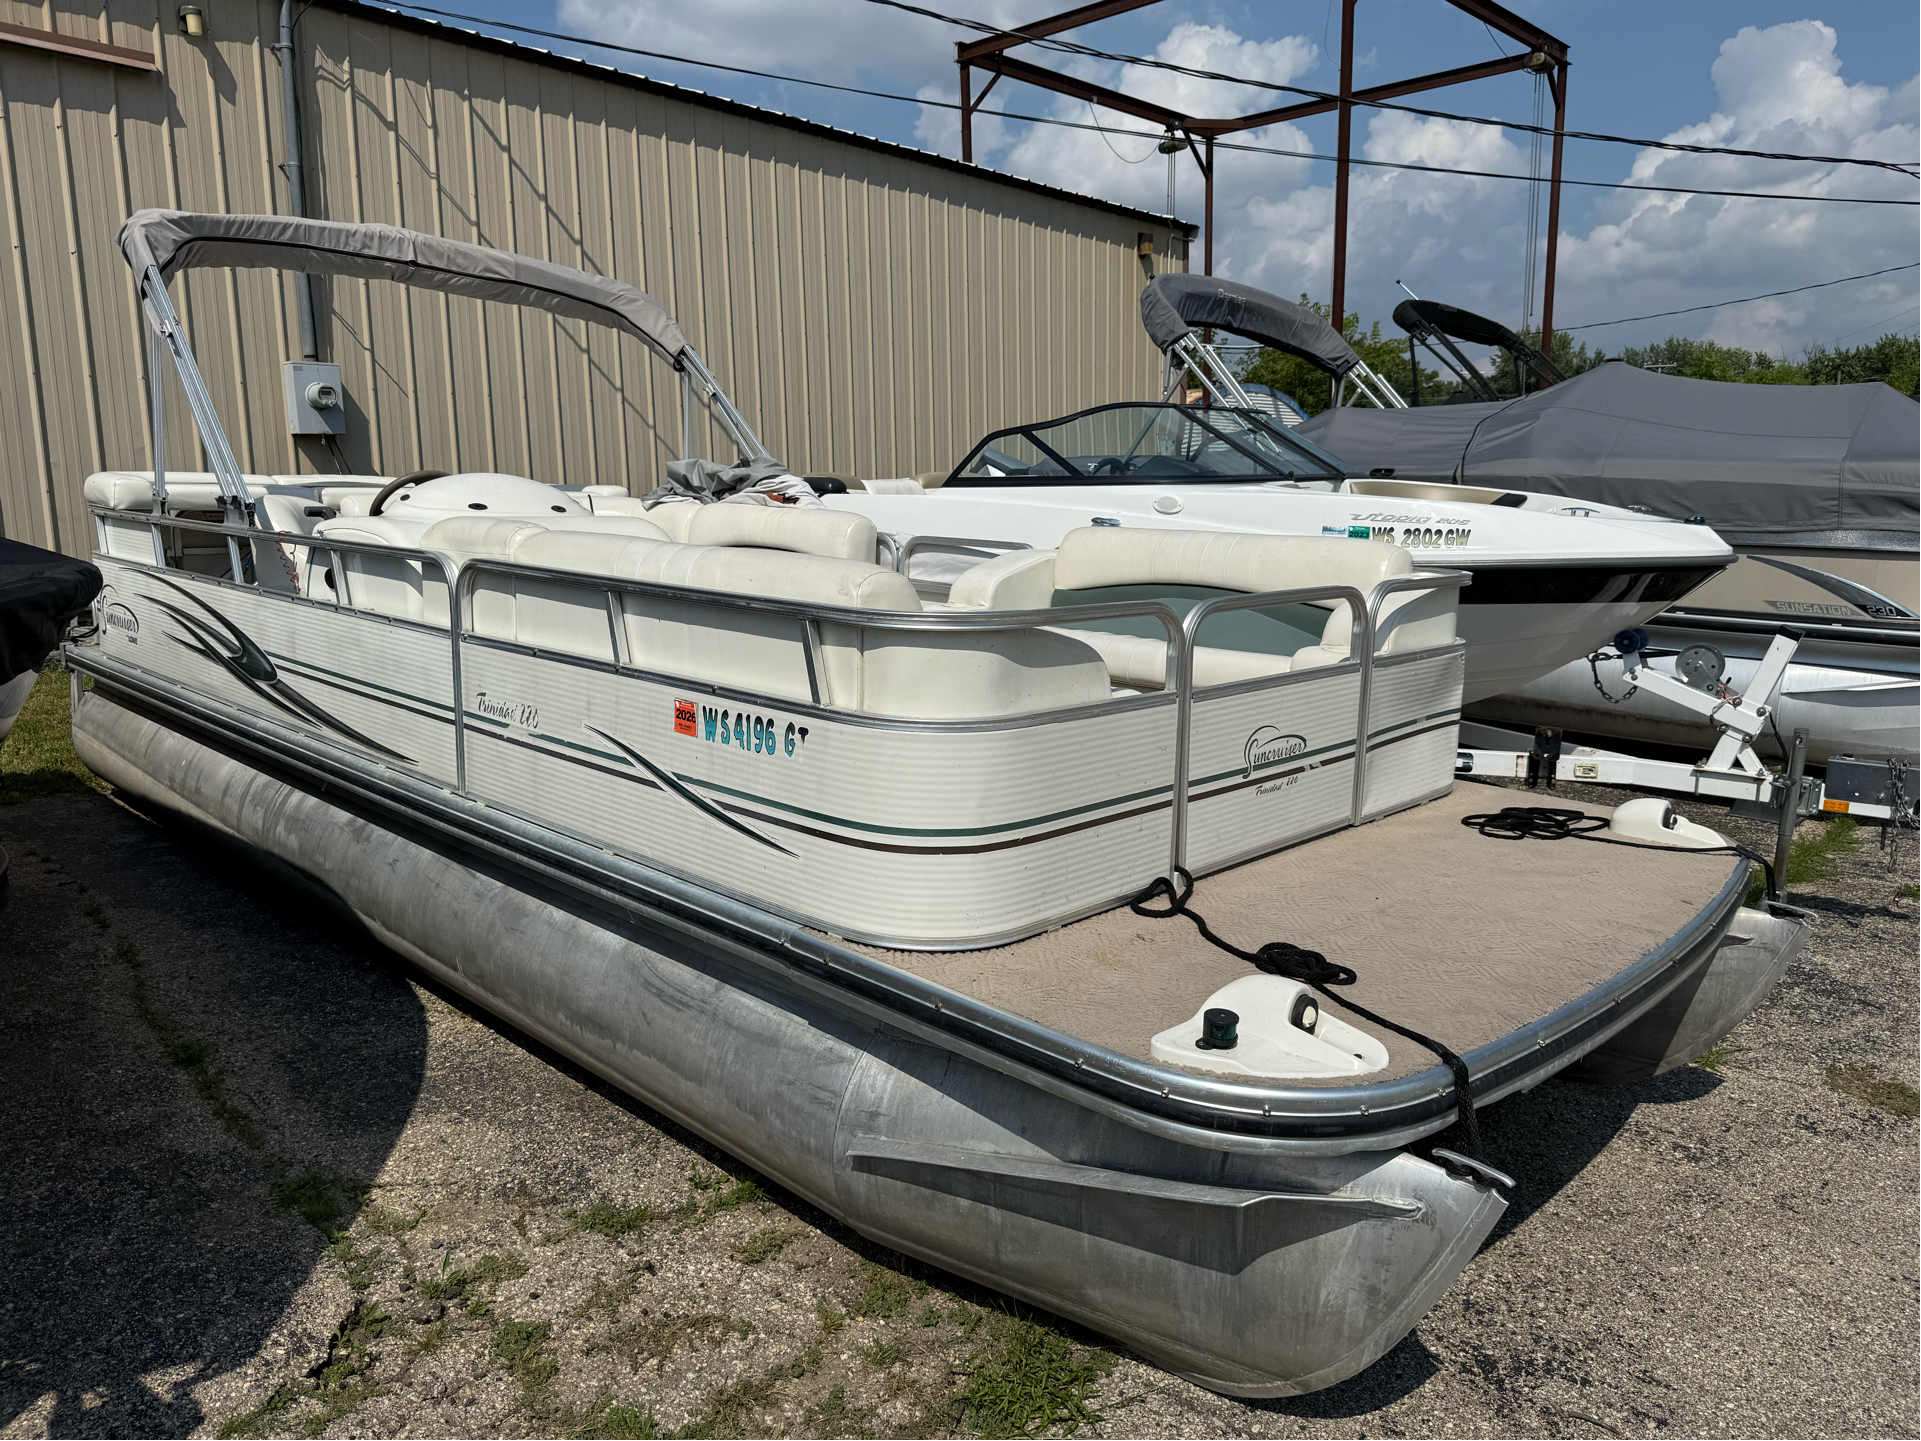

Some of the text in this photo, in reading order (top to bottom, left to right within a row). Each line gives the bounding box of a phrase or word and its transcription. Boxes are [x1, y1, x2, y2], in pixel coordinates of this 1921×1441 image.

[1349, 512, 1432, 525] Utopia
[1349, 531, 1370, 539] 2023
[1372, 526, 1395, 545] WS
[1776, 601, 1897, 617] SUNSATION 230
[675, 707, 696, 724] 2026
[1242, 737, 1305, 780] Suncruiser
